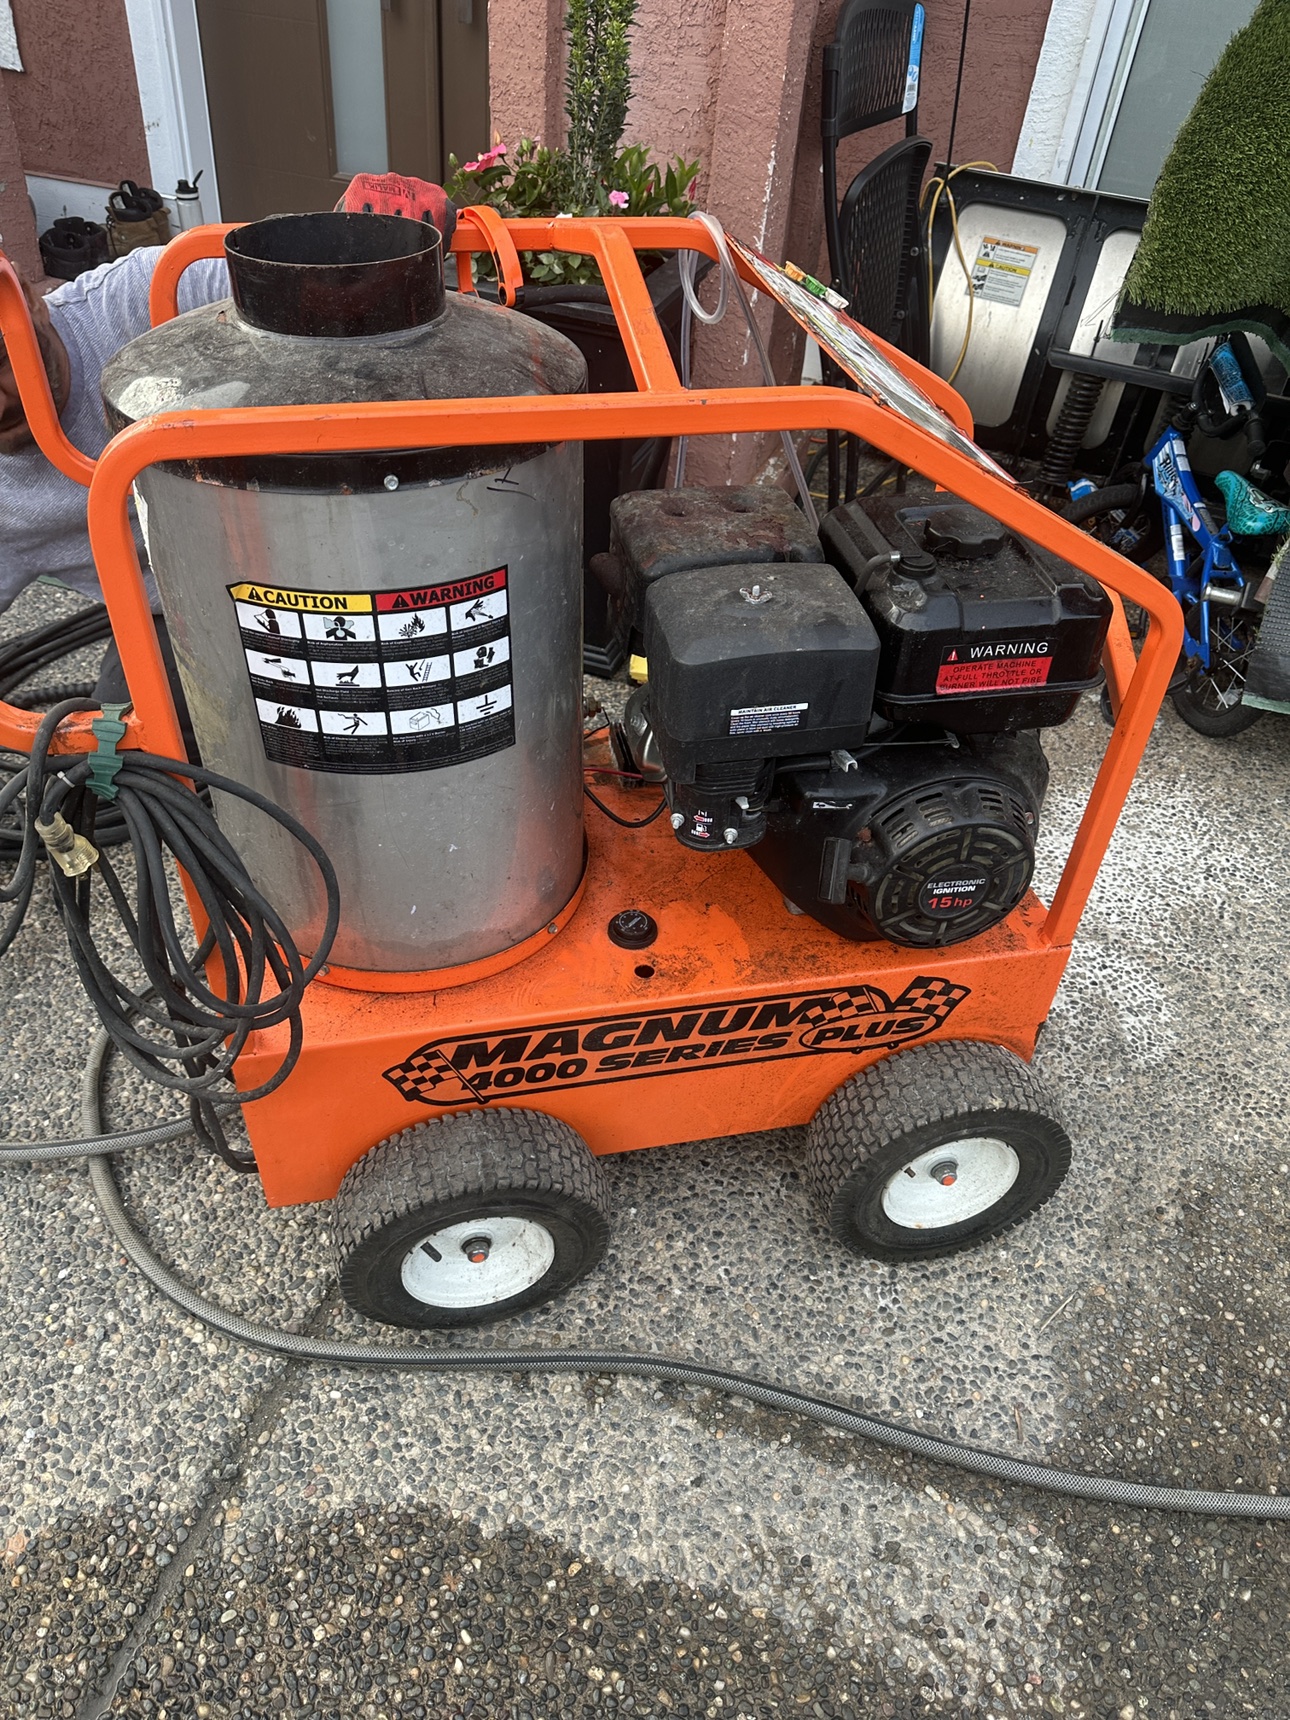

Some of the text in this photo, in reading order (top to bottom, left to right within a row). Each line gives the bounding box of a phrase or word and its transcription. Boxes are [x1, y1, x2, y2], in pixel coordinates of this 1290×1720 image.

[409, 576, 495, 606] WARNING
[263, 590, 348, 610] CAUTION
[970, 642, 1049, 659] WARNING
[953, 660, 1037, 673] OPERATE MACHINE
[982, 669, 1026, 679] THROTTLE
[979, 679, 998, 688] WILL
[1001, 677, 1020, 686] NOT
[927, 878, 986, 889] ELECTRONIC
[932, 885, 977, 895] IGNITION
[450, 997, 833, 1071] MAGNUM
[809, 1015, 932, 1046] PLUS
[461, 1031, 793, 1091] 4000 SERIES
